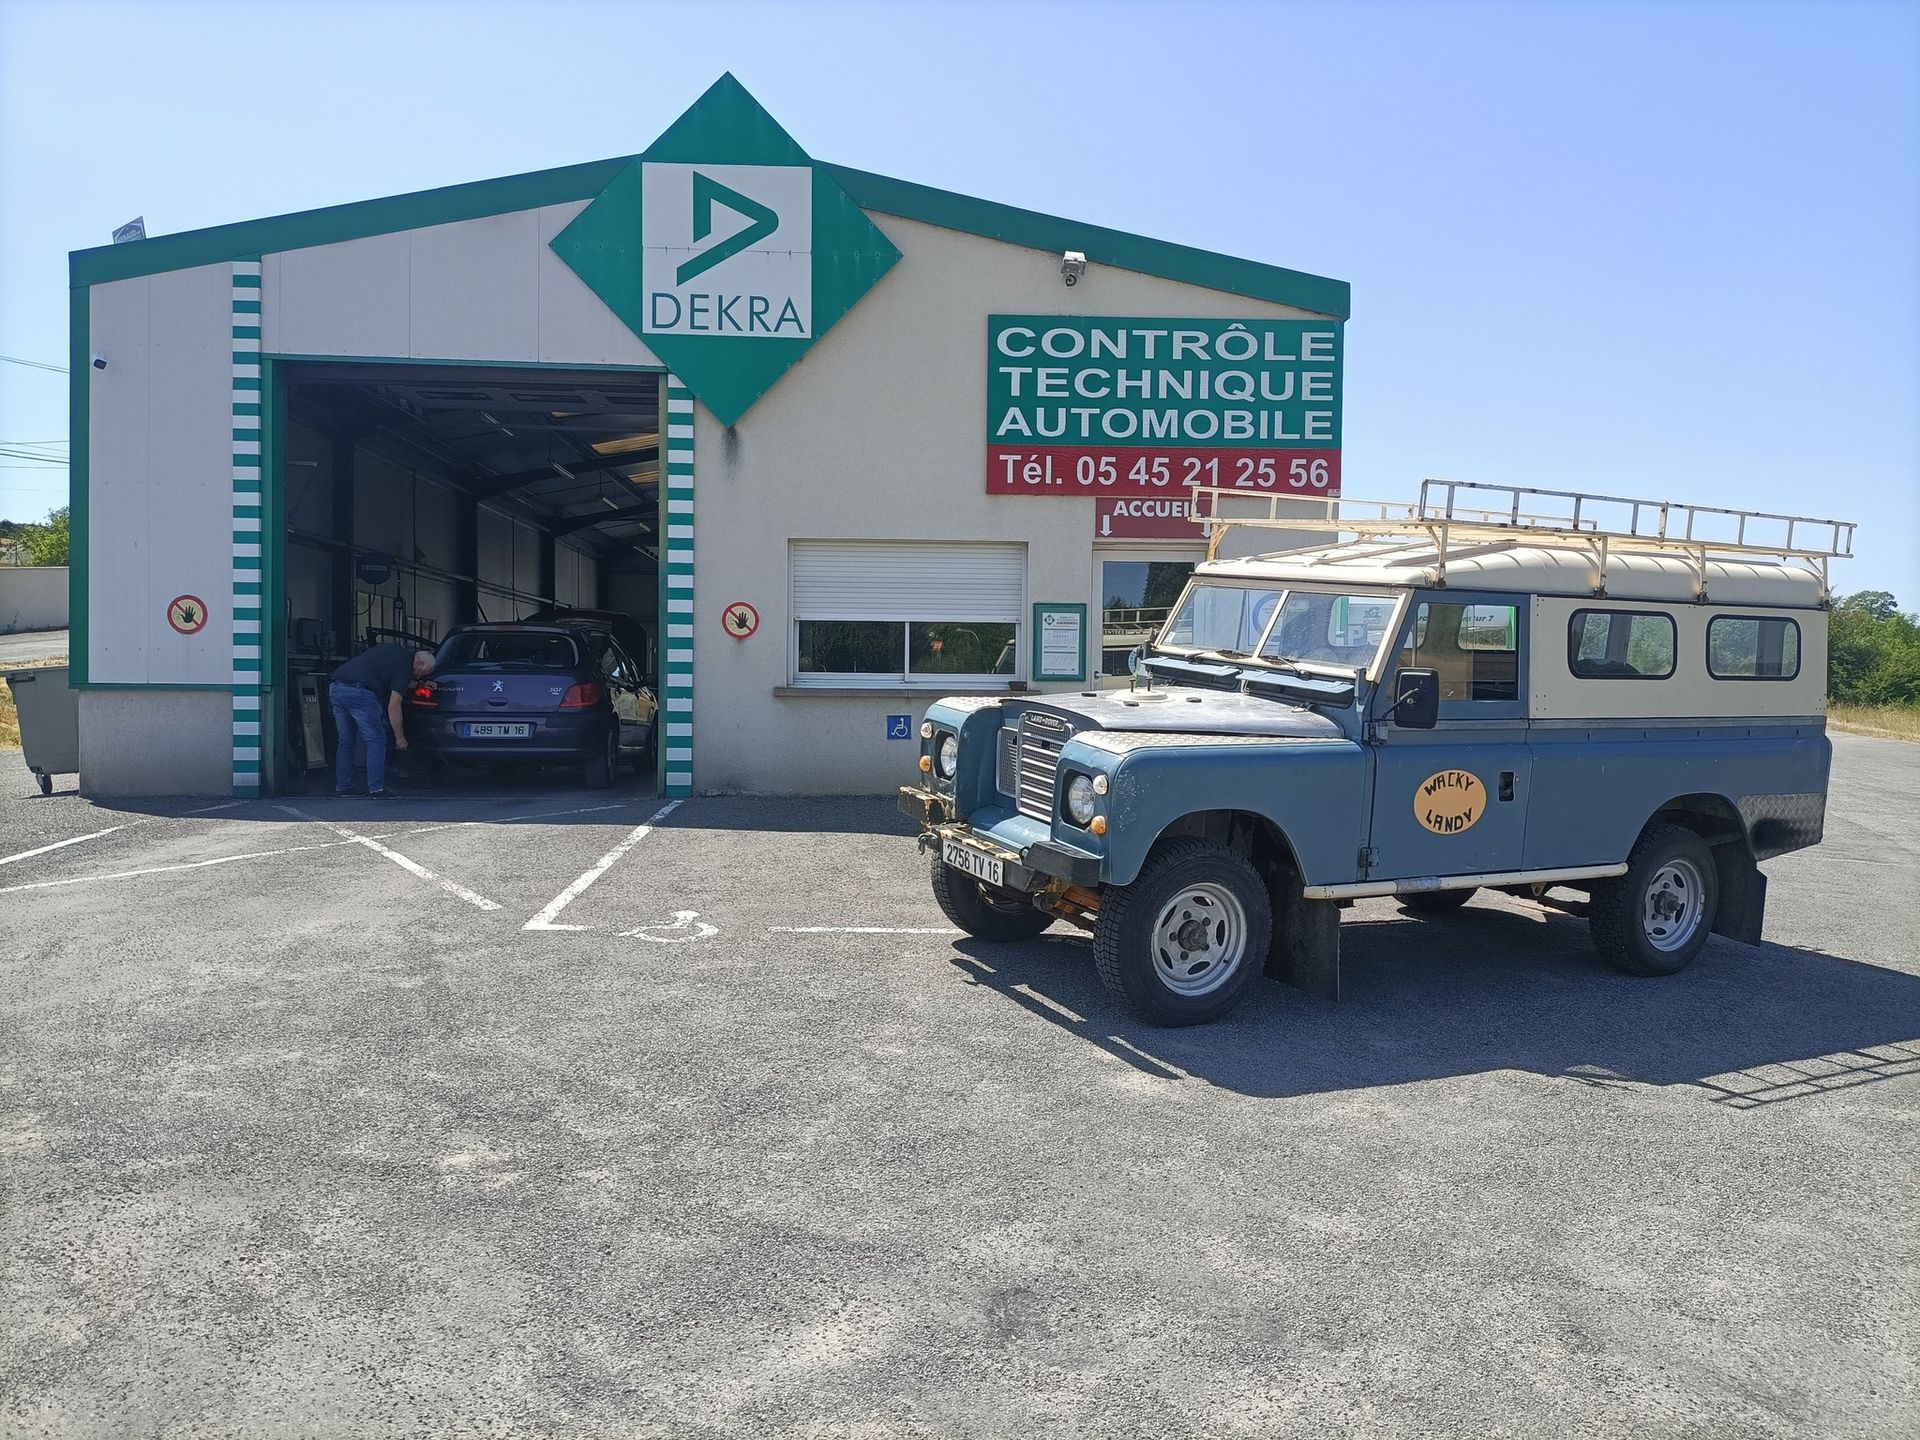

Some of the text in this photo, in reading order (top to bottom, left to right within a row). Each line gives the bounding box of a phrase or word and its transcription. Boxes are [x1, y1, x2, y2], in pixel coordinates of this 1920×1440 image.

[652, 292, 805, 333] DEKRA
[996, 322, 1336, 362] CONTRÔLE
[998, 366, 1334, 403] TECHNIQUE
[996, 406, 1334, 440] AUTOMOBILE
[999, 454, 1329, 488] Tél. 05 45 21 25 56
[473, 725, 525, 735] 489 TM 16
[1424, 772, 1474, 796] WACKY
[1425, 807, 1472, 832] LANDY
[946, 843, 999, 883] 2756 TV 16
